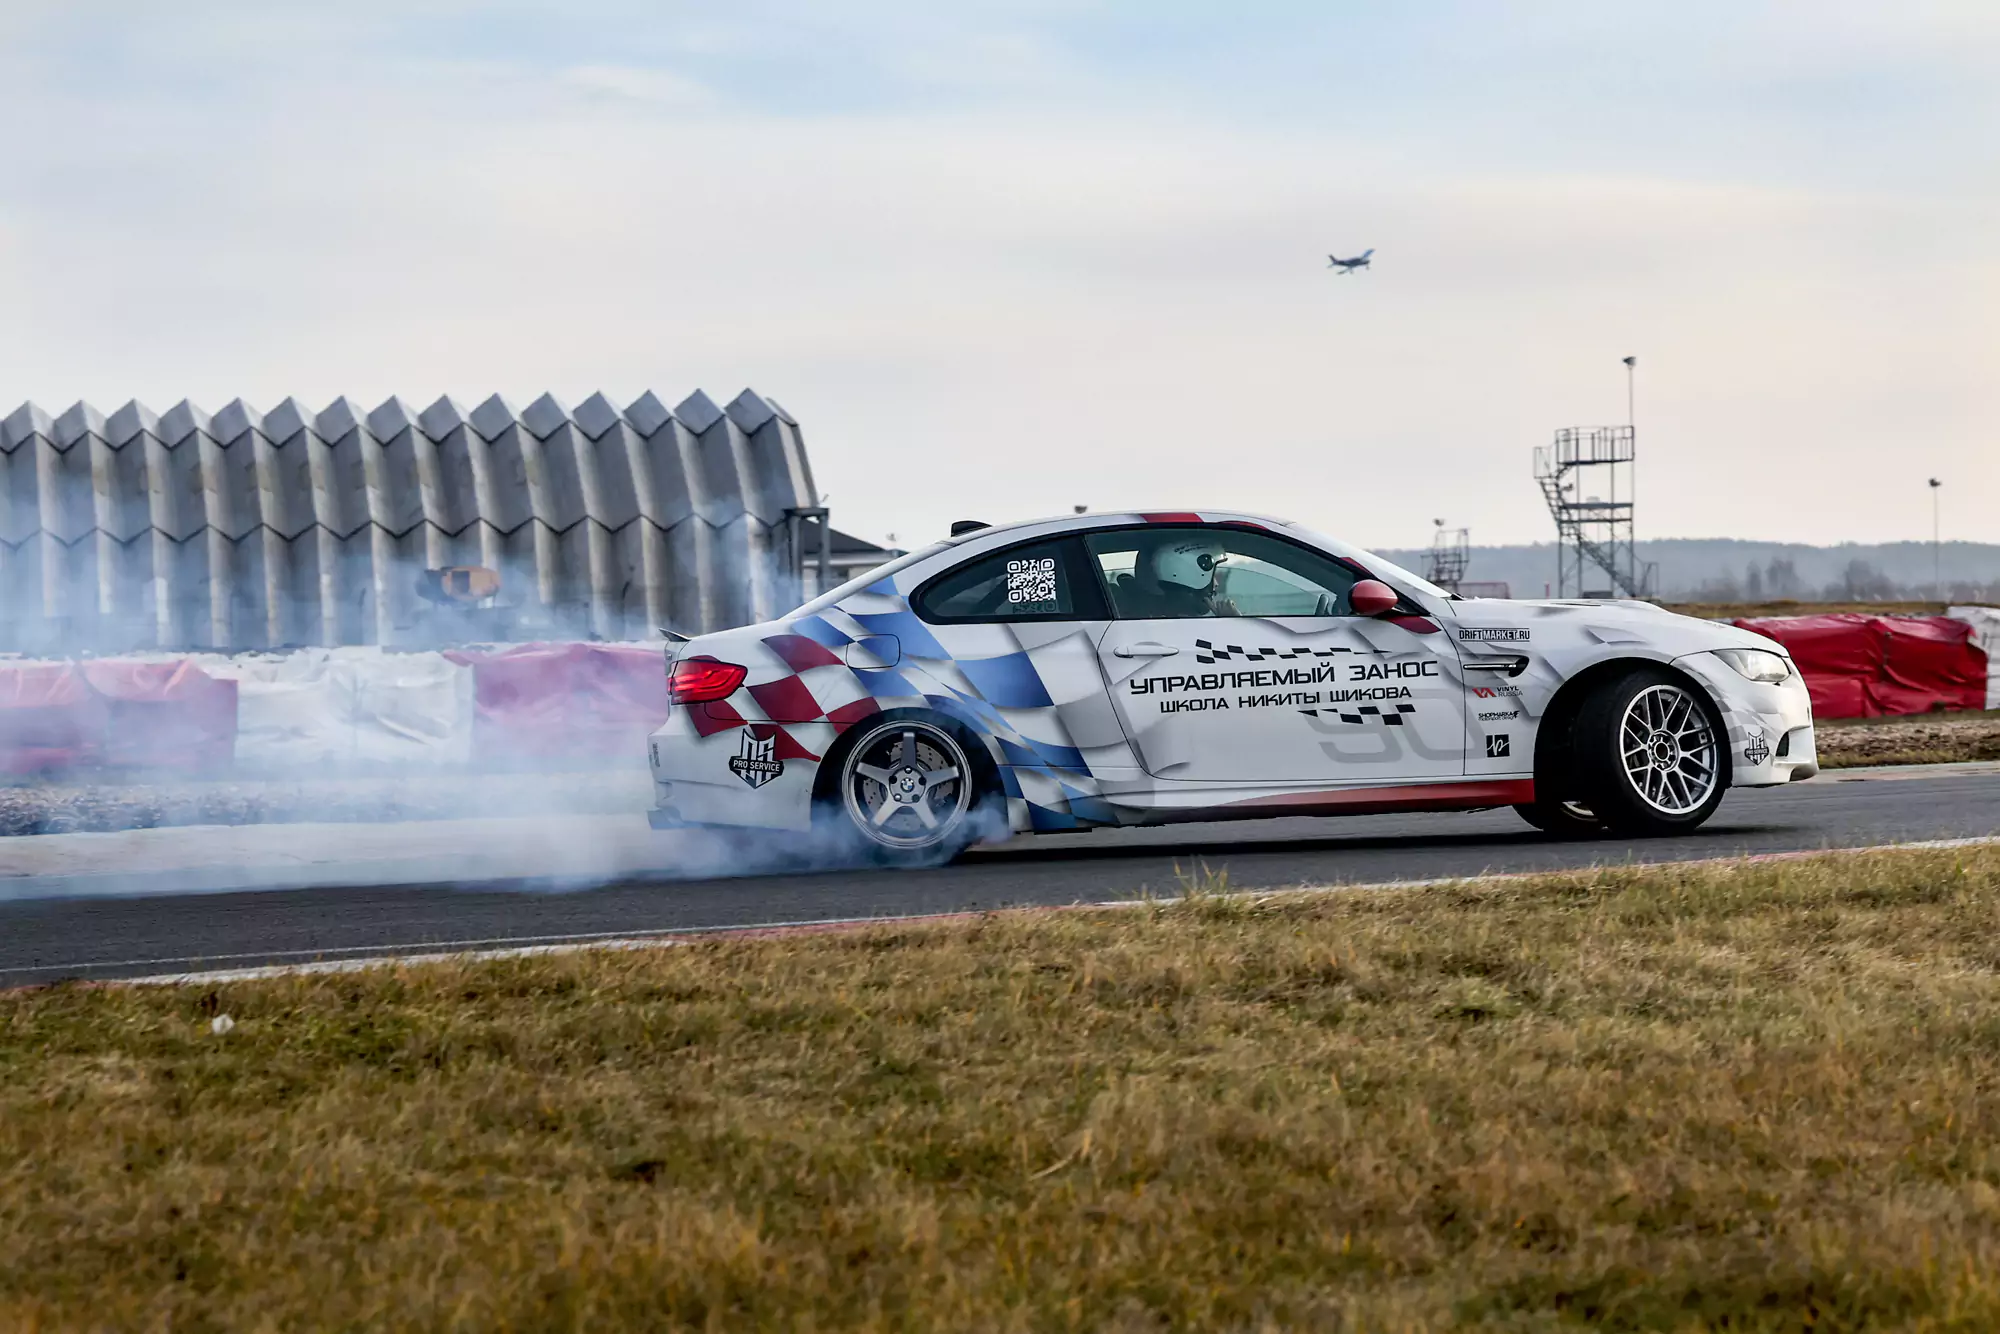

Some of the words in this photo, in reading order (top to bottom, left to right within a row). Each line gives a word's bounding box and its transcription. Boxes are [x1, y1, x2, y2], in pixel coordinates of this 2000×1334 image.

[1459, 629, 1530, 640] DRIFTMARKET.RU
[1130, 662, 1335, 695] УПРАВЛЯЕМЫЙ
[1348, 660, 1439, 682] ЗАНОС
[1160, 698, 1230, 714] ШКОЛА
[1238, 691, 1321, 708] НИКИТЫ
[1329, 686, 1413, 703] ШИКОВА
[733, 759, 748, 768] PRO
[749, 761, 780, 772] SERVICE
